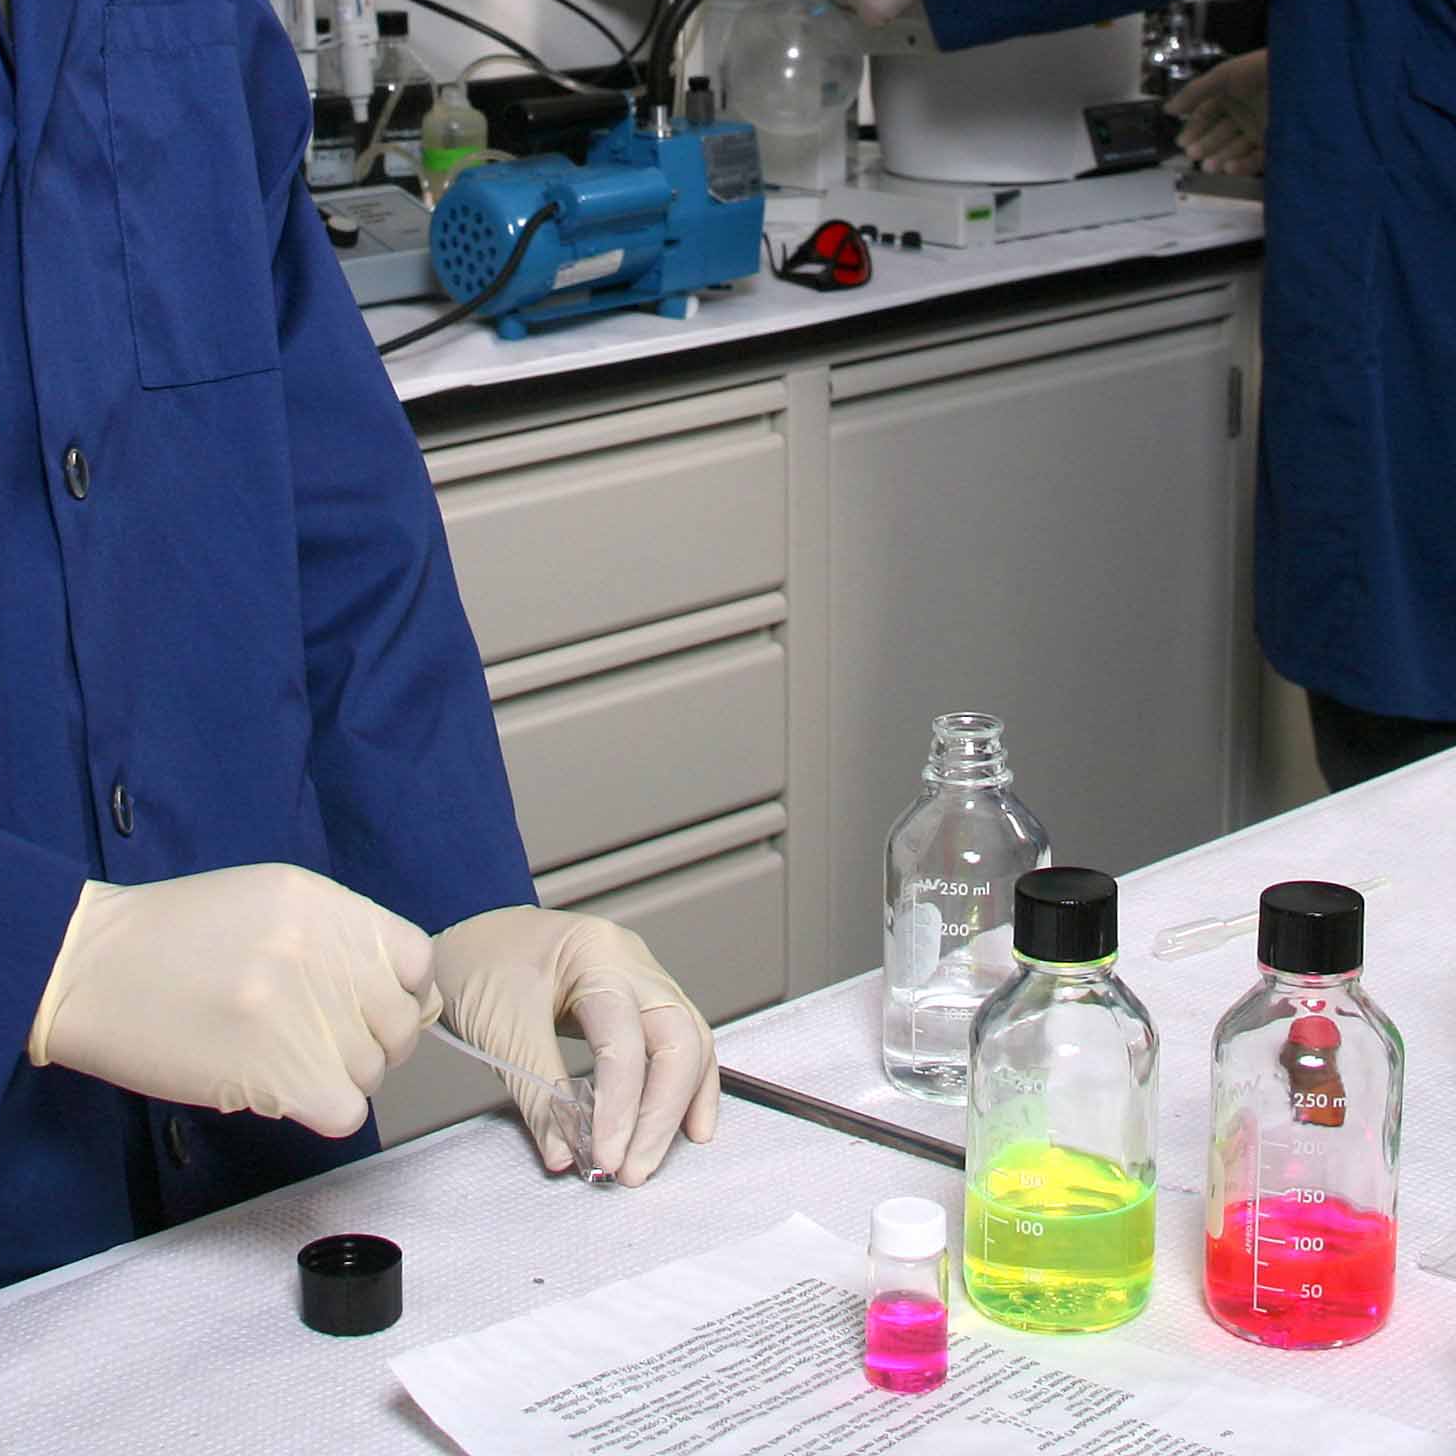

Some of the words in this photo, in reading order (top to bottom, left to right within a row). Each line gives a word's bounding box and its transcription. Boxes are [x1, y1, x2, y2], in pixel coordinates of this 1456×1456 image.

[939, 882, 969, 896] 250
[973, 881, 990, 896] ml
[941, 923, 969, 937] 200
[1294, 1092, 1328, 1109] 250
[1296, 1189, 1325, 1204] 150
[1015, 1218, 1044, 1236] 100
[1294, 1236, 1324, 1252] 100
[1300, 1284, 1323, 1299] 50
